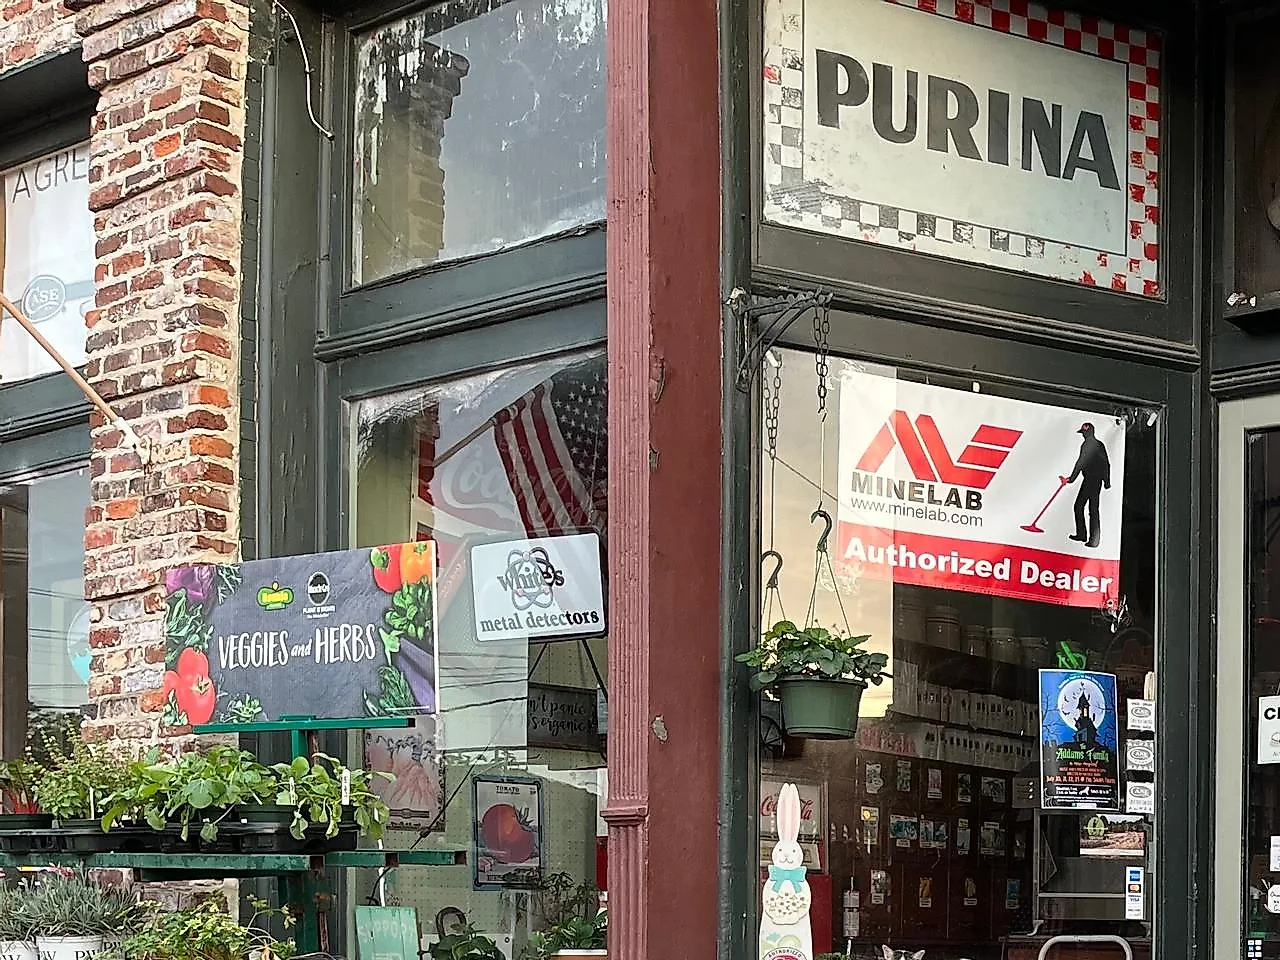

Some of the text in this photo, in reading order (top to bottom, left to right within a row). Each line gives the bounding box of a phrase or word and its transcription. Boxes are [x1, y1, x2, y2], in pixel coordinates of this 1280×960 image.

[815, 47, 1122, 191] PURINA
[850, 471, 984, 512] MINELAB
[850, 497, 984, 528] www.minelab.com
[843, 536, 1113, 594] Authorized Dealer
[480, 609, 600, 633] metal detectors
[218, 622, 377, 671] VEGGIES and HERBS
[1055, 747, 1085, 761] Addams
